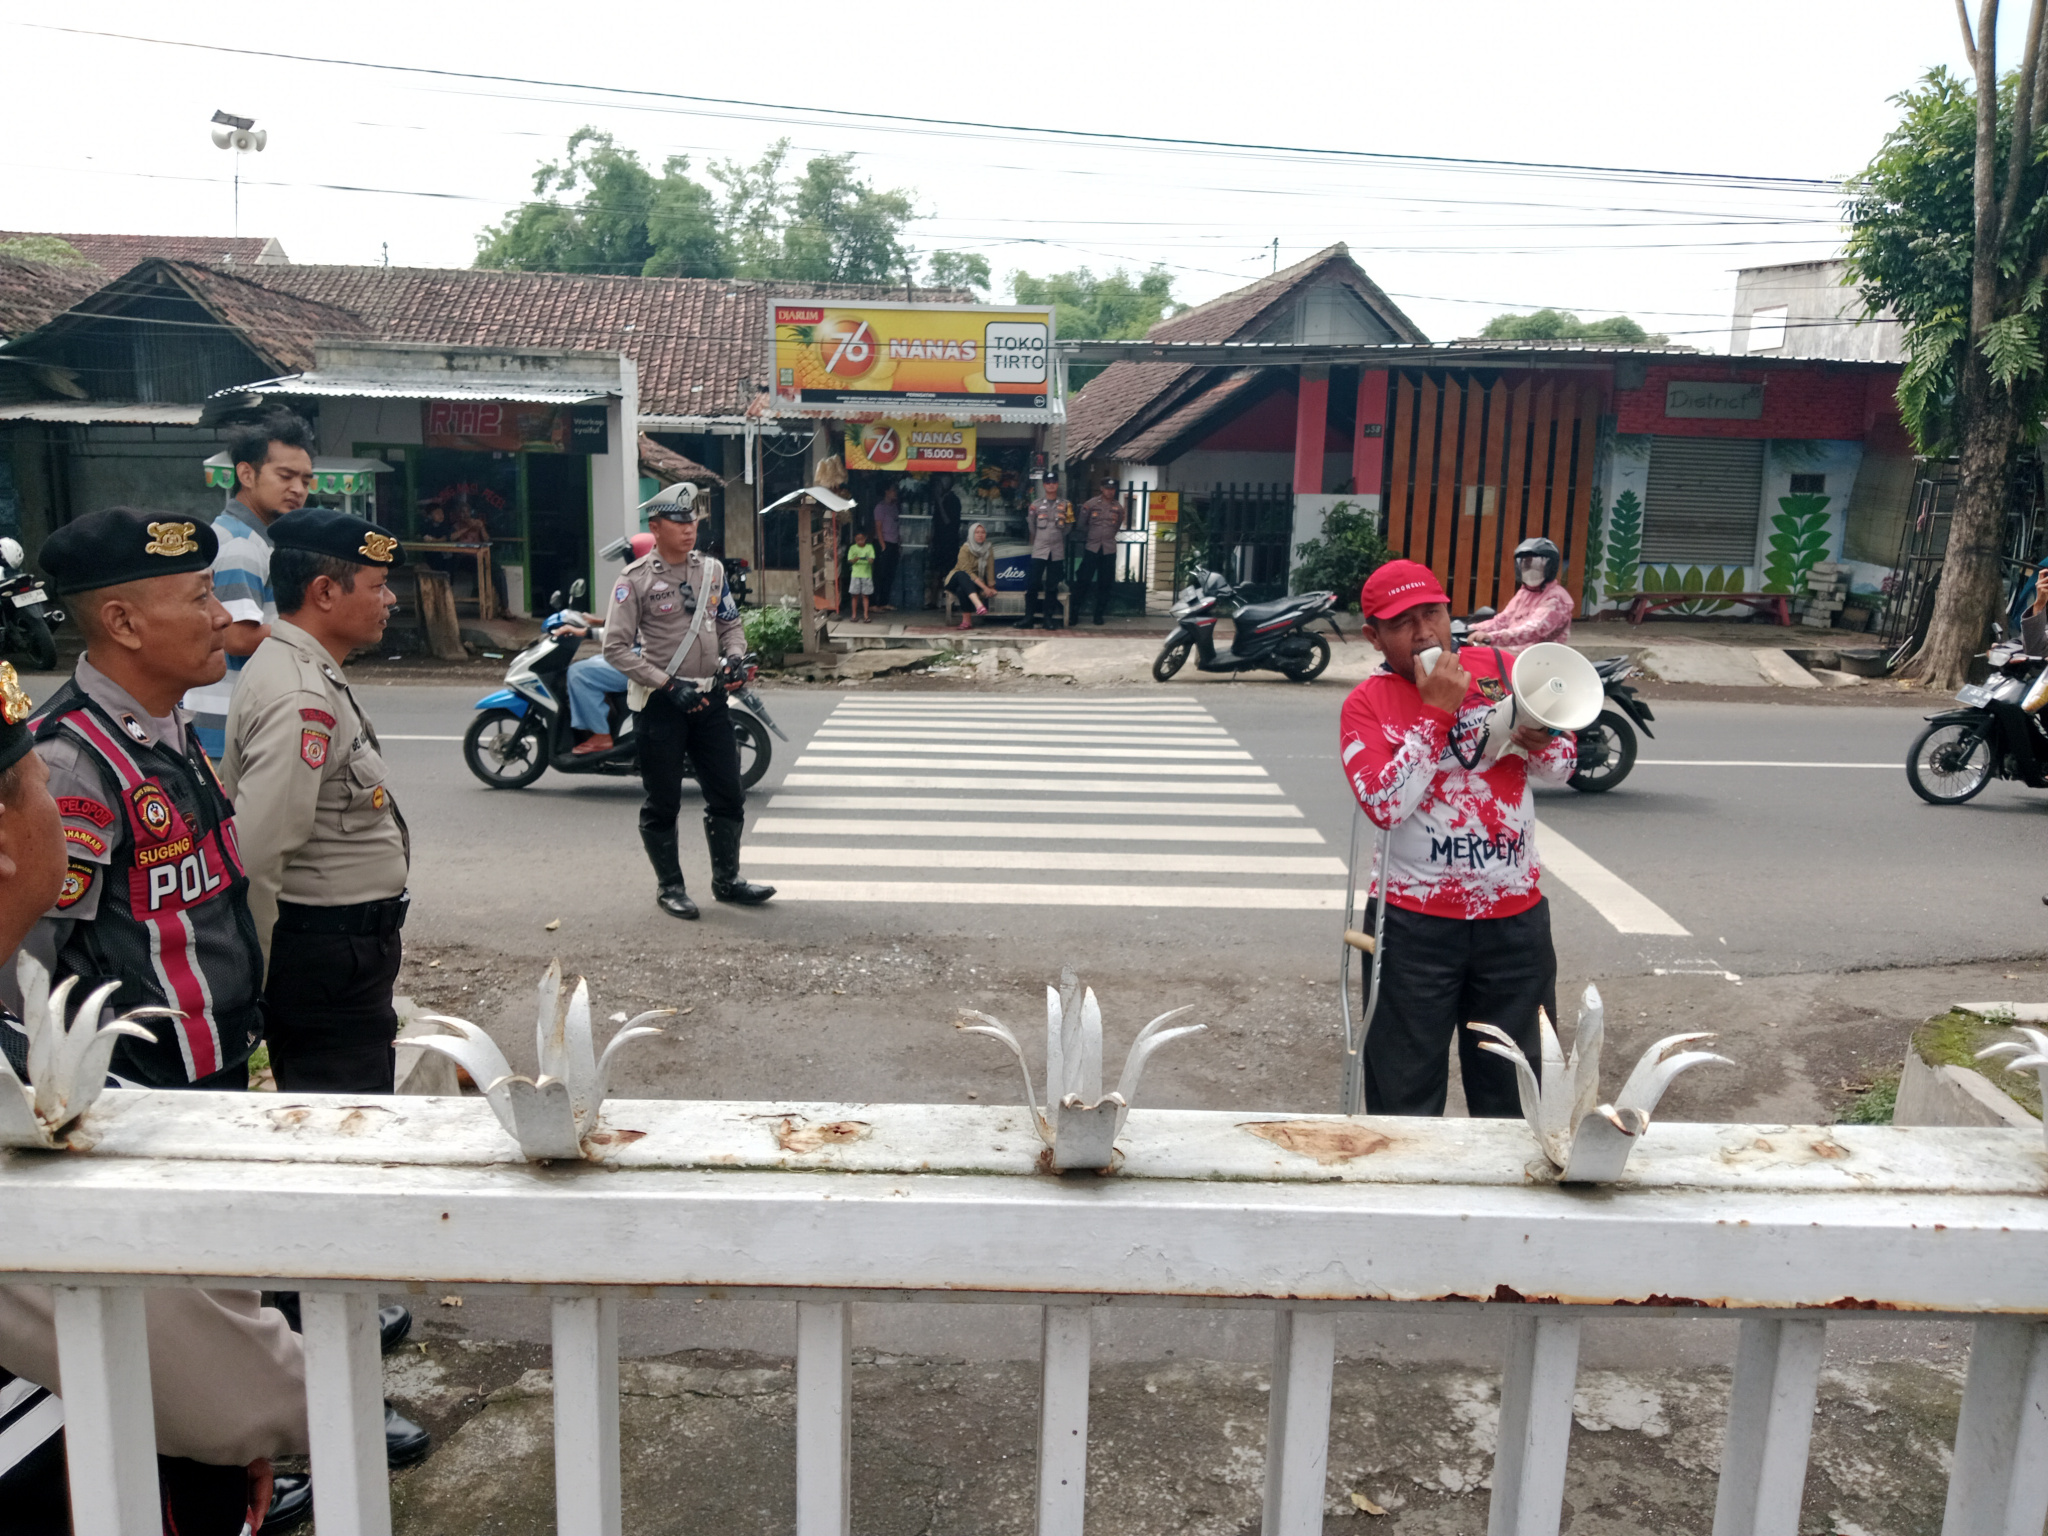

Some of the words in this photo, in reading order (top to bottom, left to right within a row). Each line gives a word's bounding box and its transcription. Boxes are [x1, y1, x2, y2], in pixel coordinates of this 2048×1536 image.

[778, 310, 819, 321] DJARUM
[825, 320, 869, 374] 76
[889, 338, 977, 361] NANAS
[994, 336, 1044, 351] TOKO
[993, 355, 1045, 370] TIRTO
[1669, 390, 1749, 410] District
[867, 427, 894, 460] 76
[912, 431, 962, 444] NANAS
[996, 566, 1026, 579] Aice
[650, 590, 676, 601] ROCKY
[1387, 581, 1426, 596] INDONESIA
[61, 800, 109, 826] PELOPOR
[63, 830, 102, 850] AHARKAM
[139, 837, 190, 865] SUGENG
[148, 847, 221, 911] POL
